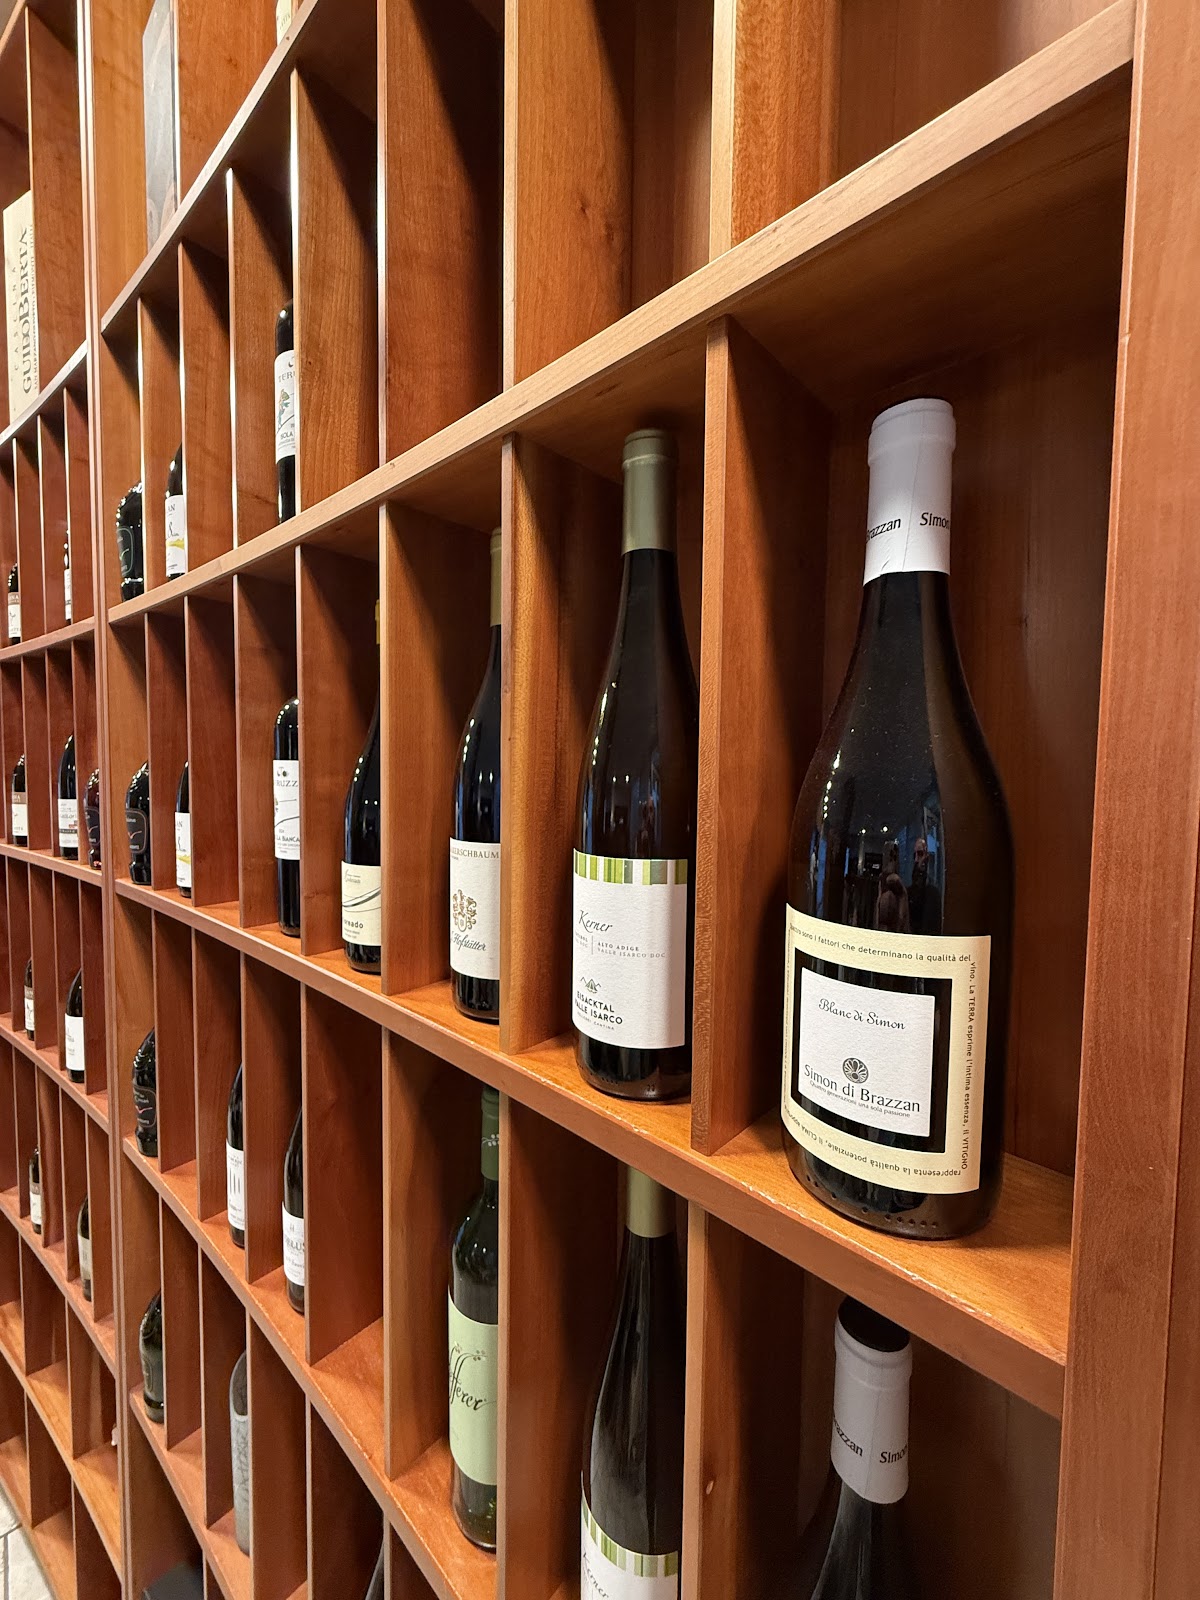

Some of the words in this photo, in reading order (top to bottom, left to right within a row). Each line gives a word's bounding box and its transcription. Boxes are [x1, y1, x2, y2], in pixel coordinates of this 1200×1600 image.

[578, 909, 613, 934] Kerner
[598, 948, 616, 956] VALLE
[818, 936, 840, 948] fattori
[842, 942, 856, 952] che
[858, 946, 913, 960] determinano
[927, 954, 956, 962] qualità
[959, 954, 971, 962] del
[969, 962, 977, 982] vino.
[969, 985, 976, 994] La
[577, 990, 615, 1013] EISACKTAL
[968, 997, 976, 1022] TERRA
[590, 1009, 623, 1025] ISARCO
[818, 998, 852, 1019] Blanc
[853, 1009, 863, 1022] di
[866, 1011, 906, 1030] Simon
[804, 1064, 838, 1091] Simon
[842, 1083, 855, 1098] di
[860, 1088, 920, 1112] Brazzan
[870, 1105, 883, 1113] sola
[884, 1107, 910, 1118] passione
[962, 1093, 970, 1127] essenza,
[825, 1139, 867, 1163] potenziale,
[961, 1137, 969, 1170] VITIGNO
[870, 1158, 900, 1173] qualità
[914, 1168, 961, 1177] rappresenta
